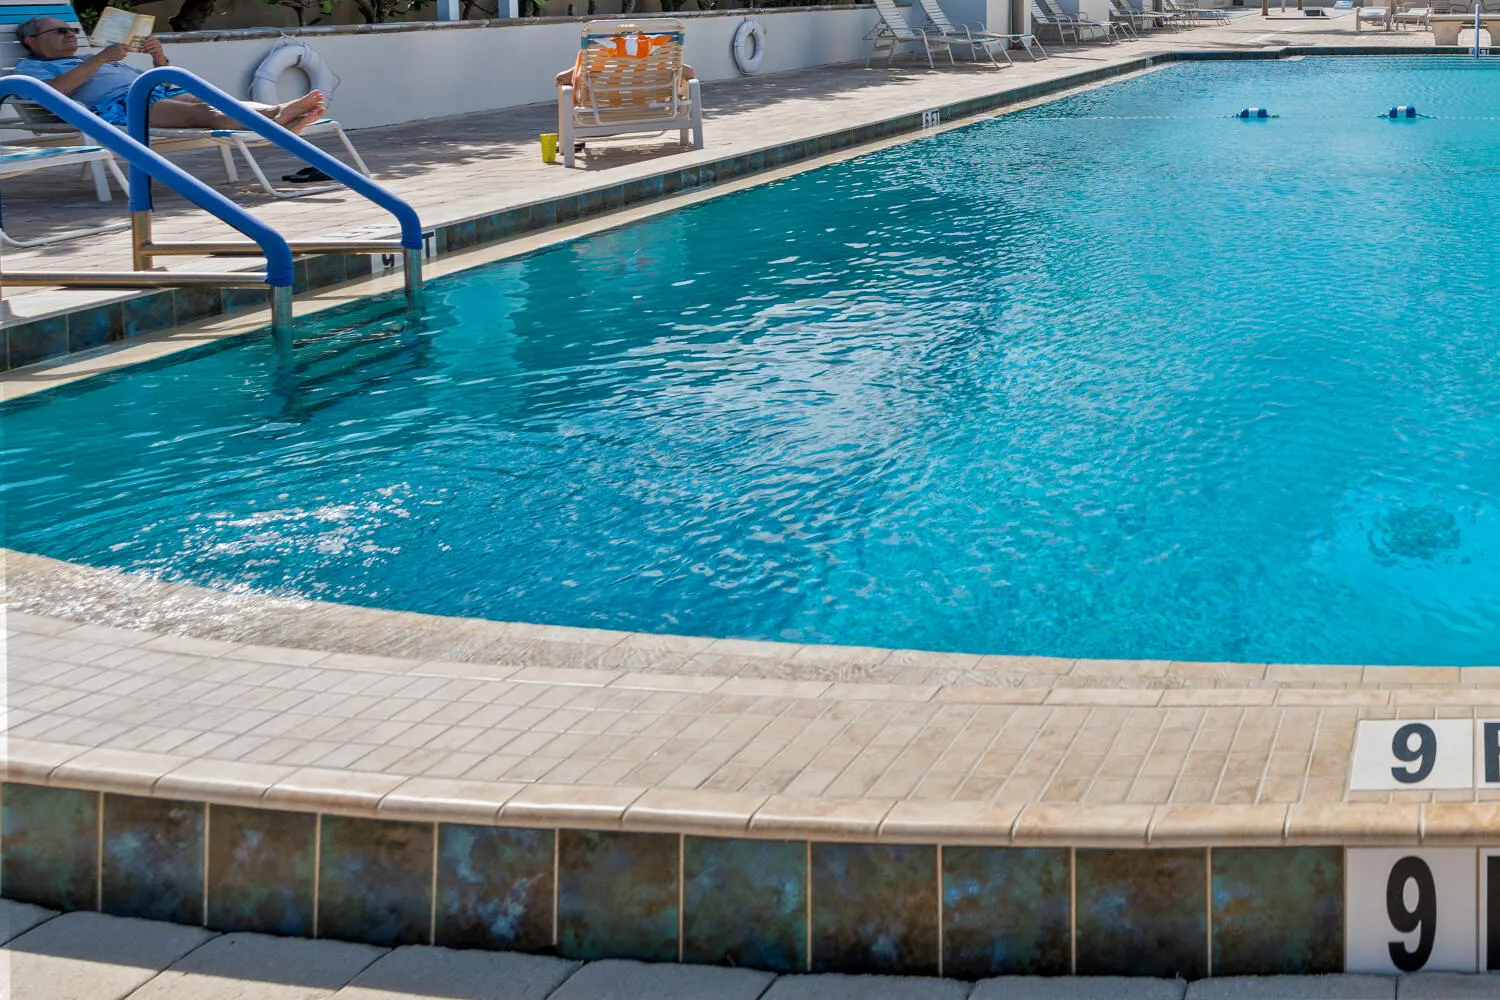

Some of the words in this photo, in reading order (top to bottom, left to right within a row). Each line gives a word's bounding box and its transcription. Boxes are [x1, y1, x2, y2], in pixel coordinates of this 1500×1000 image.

[931, 110, 939, 126] FT
[1391, 723, 1437, 783] 9
[1386, 855, 1437, 972] 9
